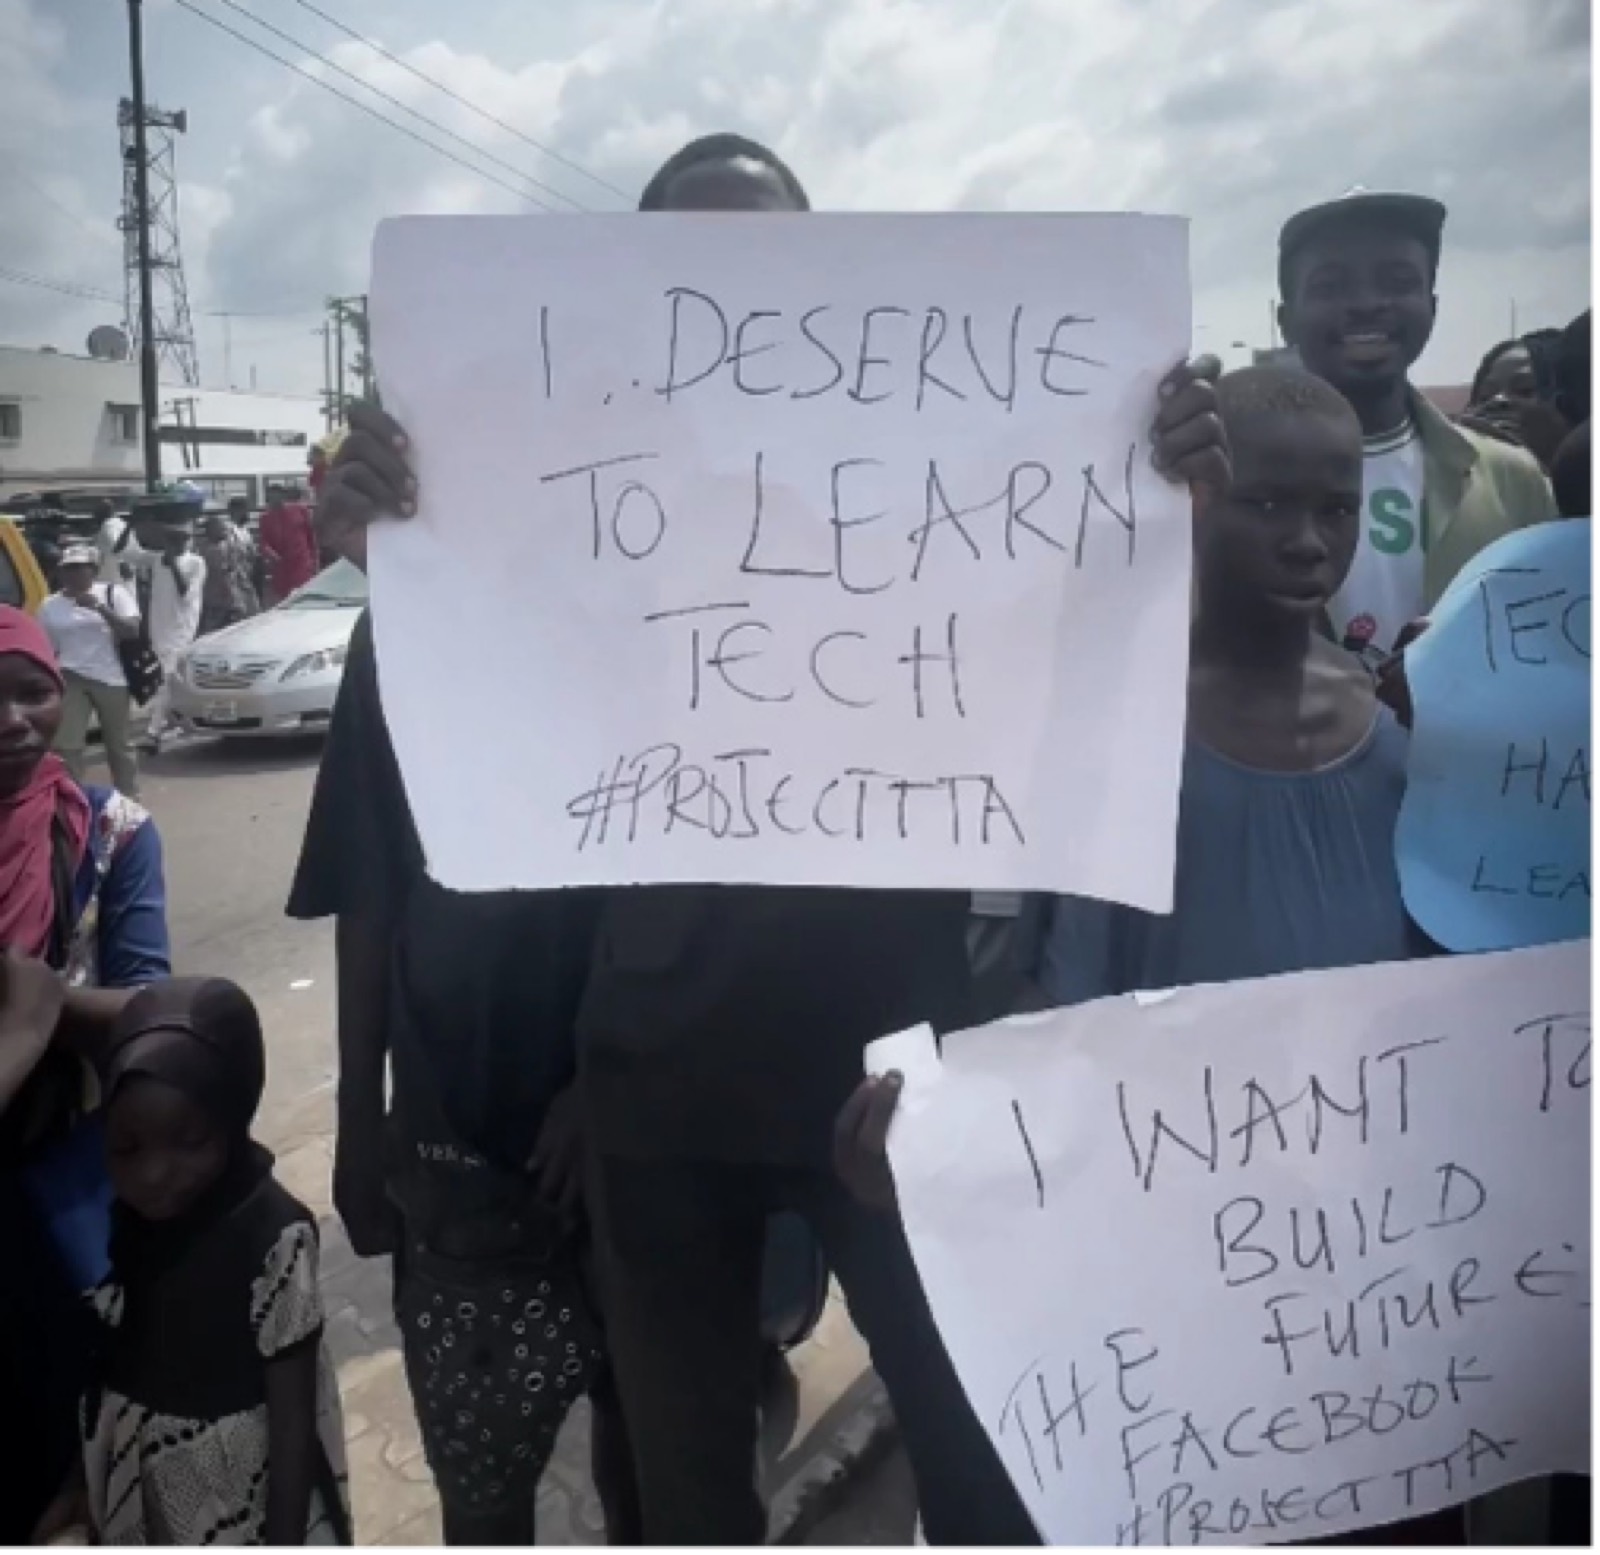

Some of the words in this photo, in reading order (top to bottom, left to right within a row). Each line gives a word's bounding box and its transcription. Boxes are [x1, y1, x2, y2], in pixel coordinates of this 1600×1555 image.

[541, 305, 551, 399] I
[540, 452, 665, 560] TO
[739, 442, 1136, 594] LEARN
[643, 601, 965, 718] TECH
[1011, 1099, 1045, 1208] I
[1116, 1036, 1448, 1193] WANT
[1213, 1162, 1487, 1287] BUILD
[998, 1327, 1160, 1492] THE
[1261, 1250, 1578, 1376] FUTURE
[1119, 1355, 1493, 1499] FACEBOOK
